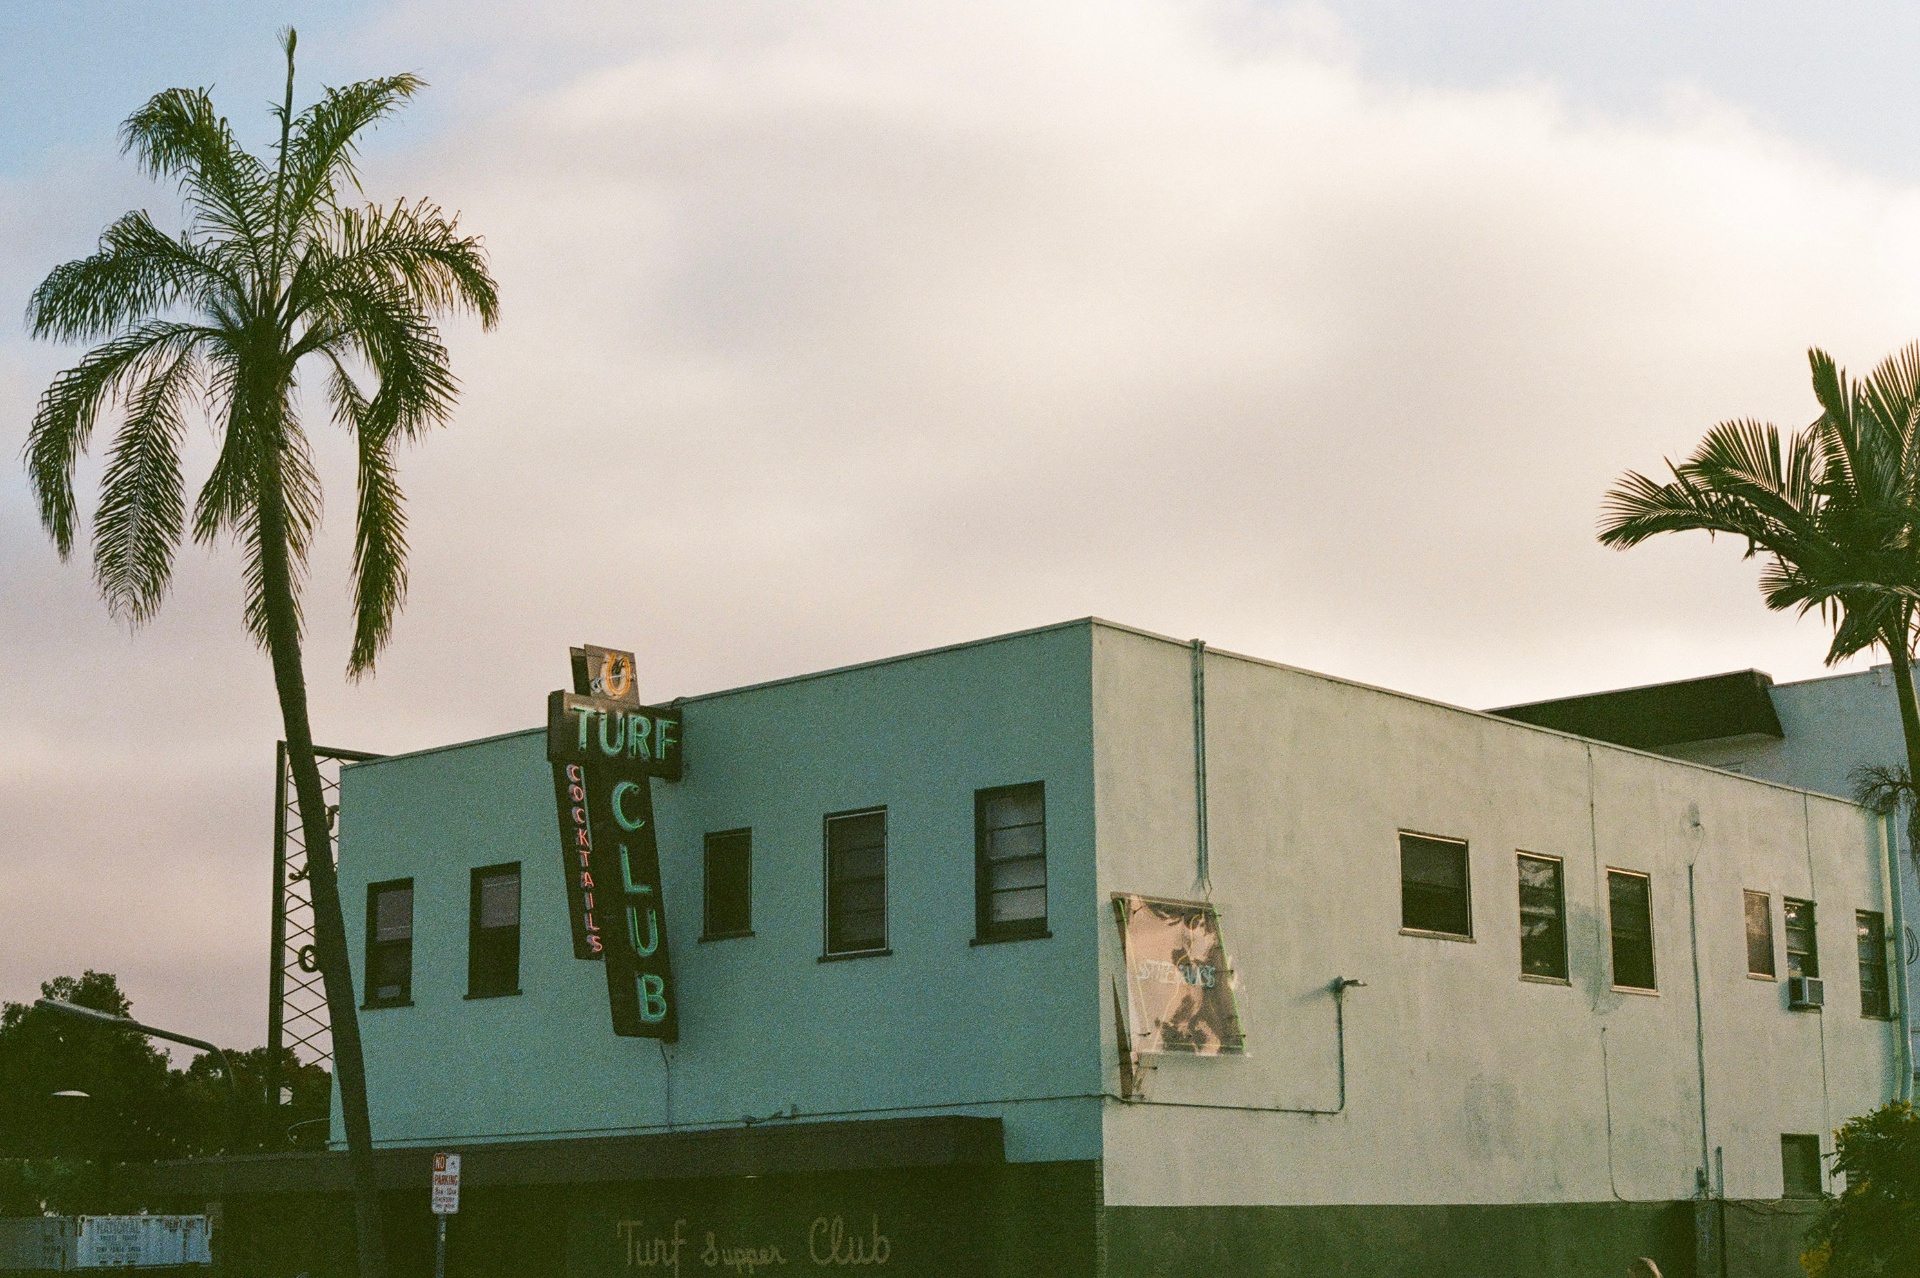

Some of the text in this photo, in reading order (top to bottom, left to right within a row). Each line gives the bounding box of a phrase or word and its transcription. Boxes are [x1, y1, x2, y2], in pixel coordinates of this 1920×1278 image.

[569, 704, 679, 761] TURF
[566, 763, 603, 953] COCKTAILS
[612, 781, 668, 1023] CLUB
[434, 1175, 458, 1186] PARKING
[435, 1156, 445, 1169] NO
[617, 1213, 891, 1278] Turf Supper Club
